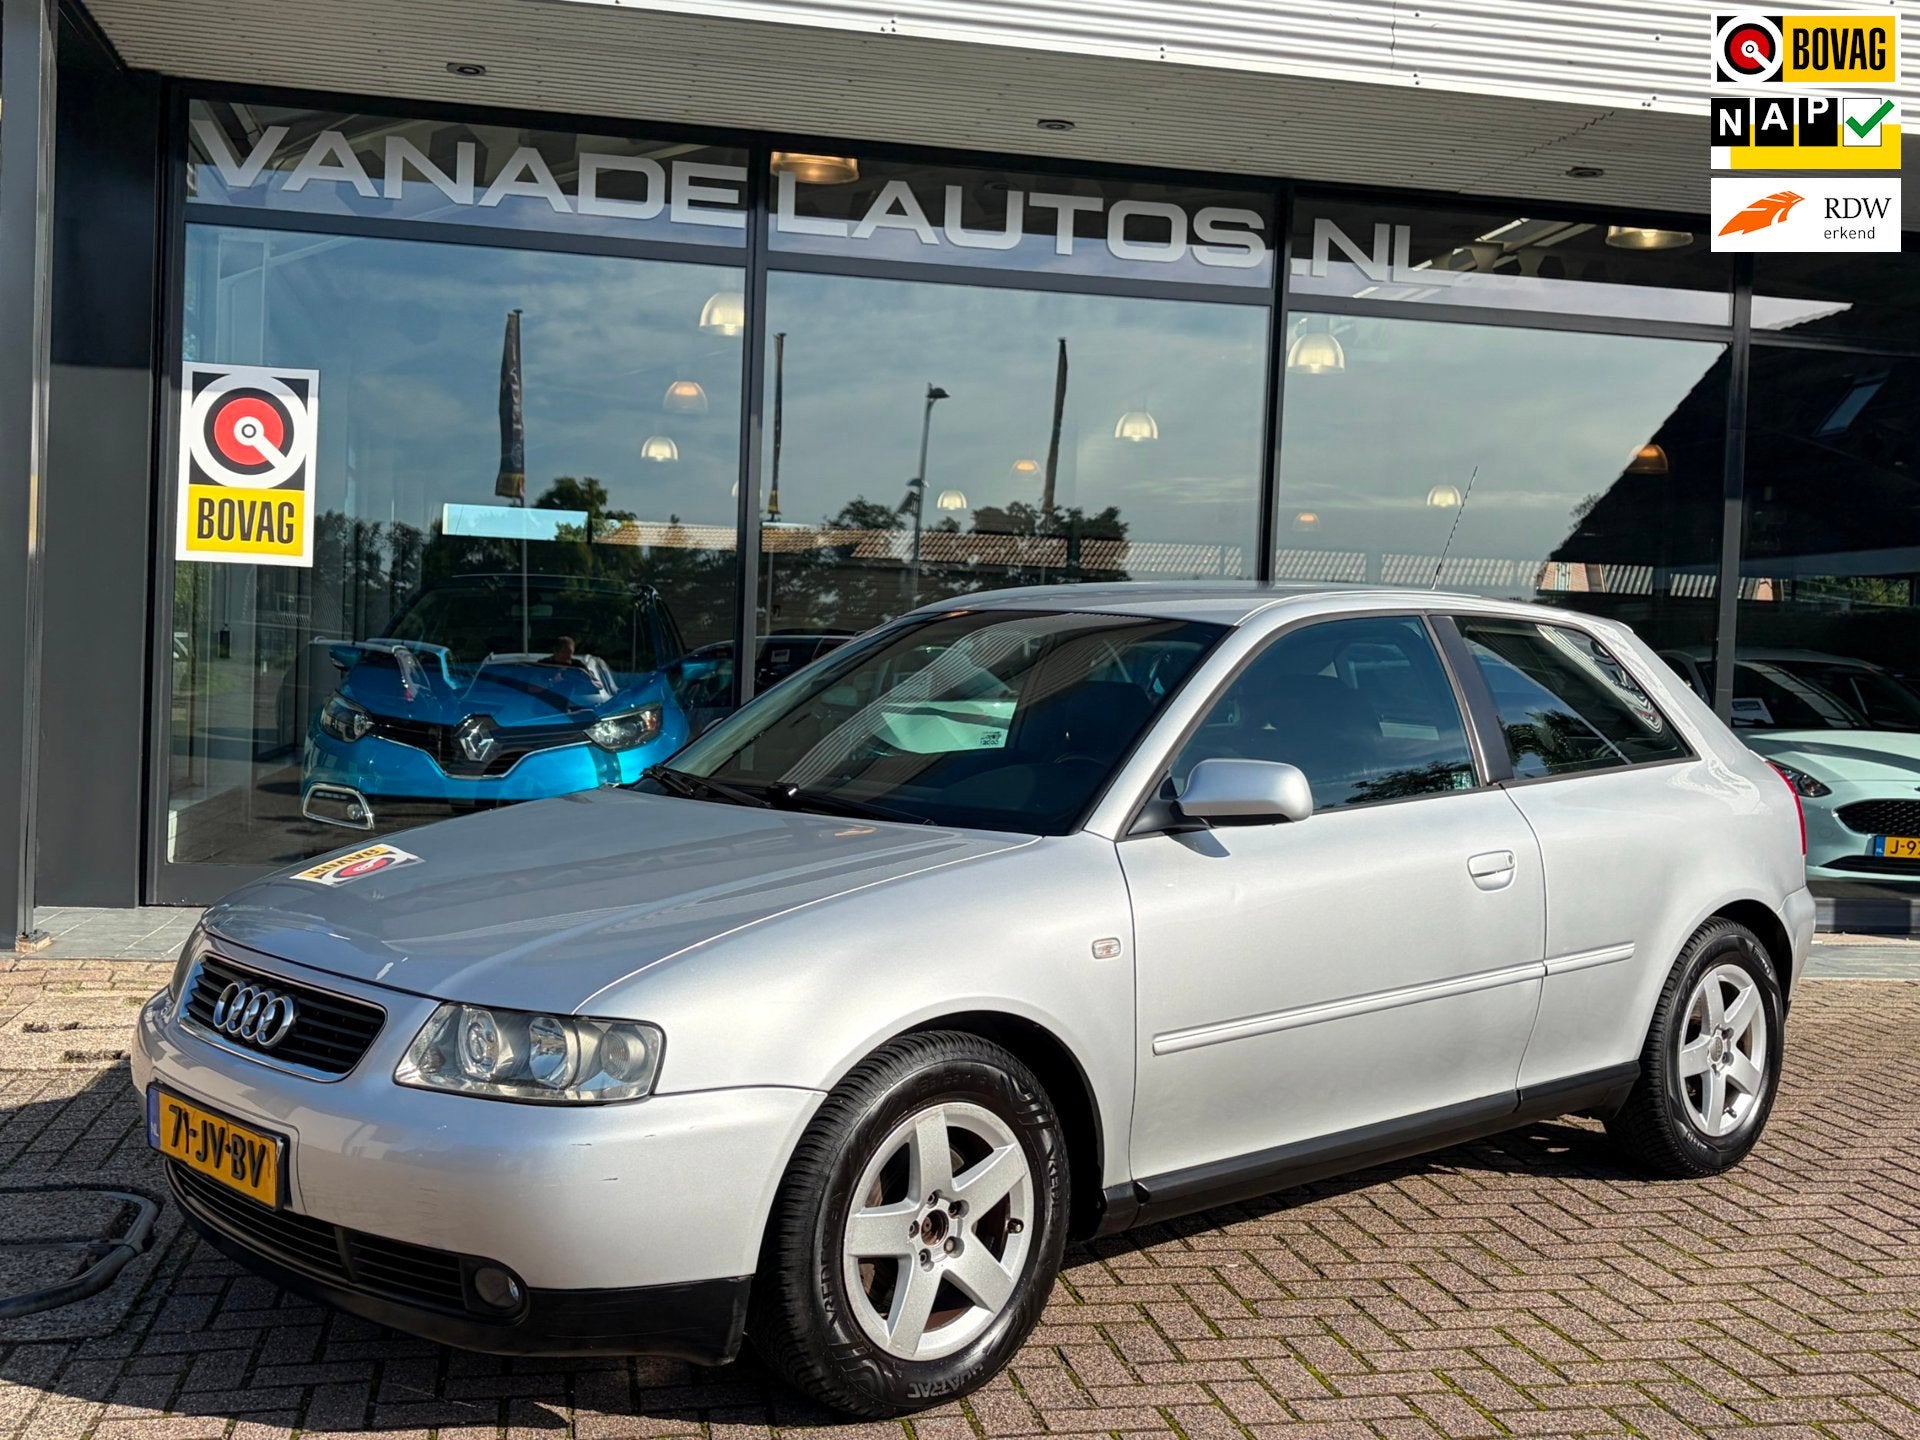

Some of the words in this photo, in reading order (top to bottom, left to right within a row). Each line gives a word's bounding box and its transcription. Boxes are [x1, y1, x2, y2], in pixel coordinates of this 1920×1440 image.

[197, 497, 295, 544] BOVAG
[1889, 840, 1920, 855] J-9
[168, 1103, 267, 1188] 71-JV-BV
